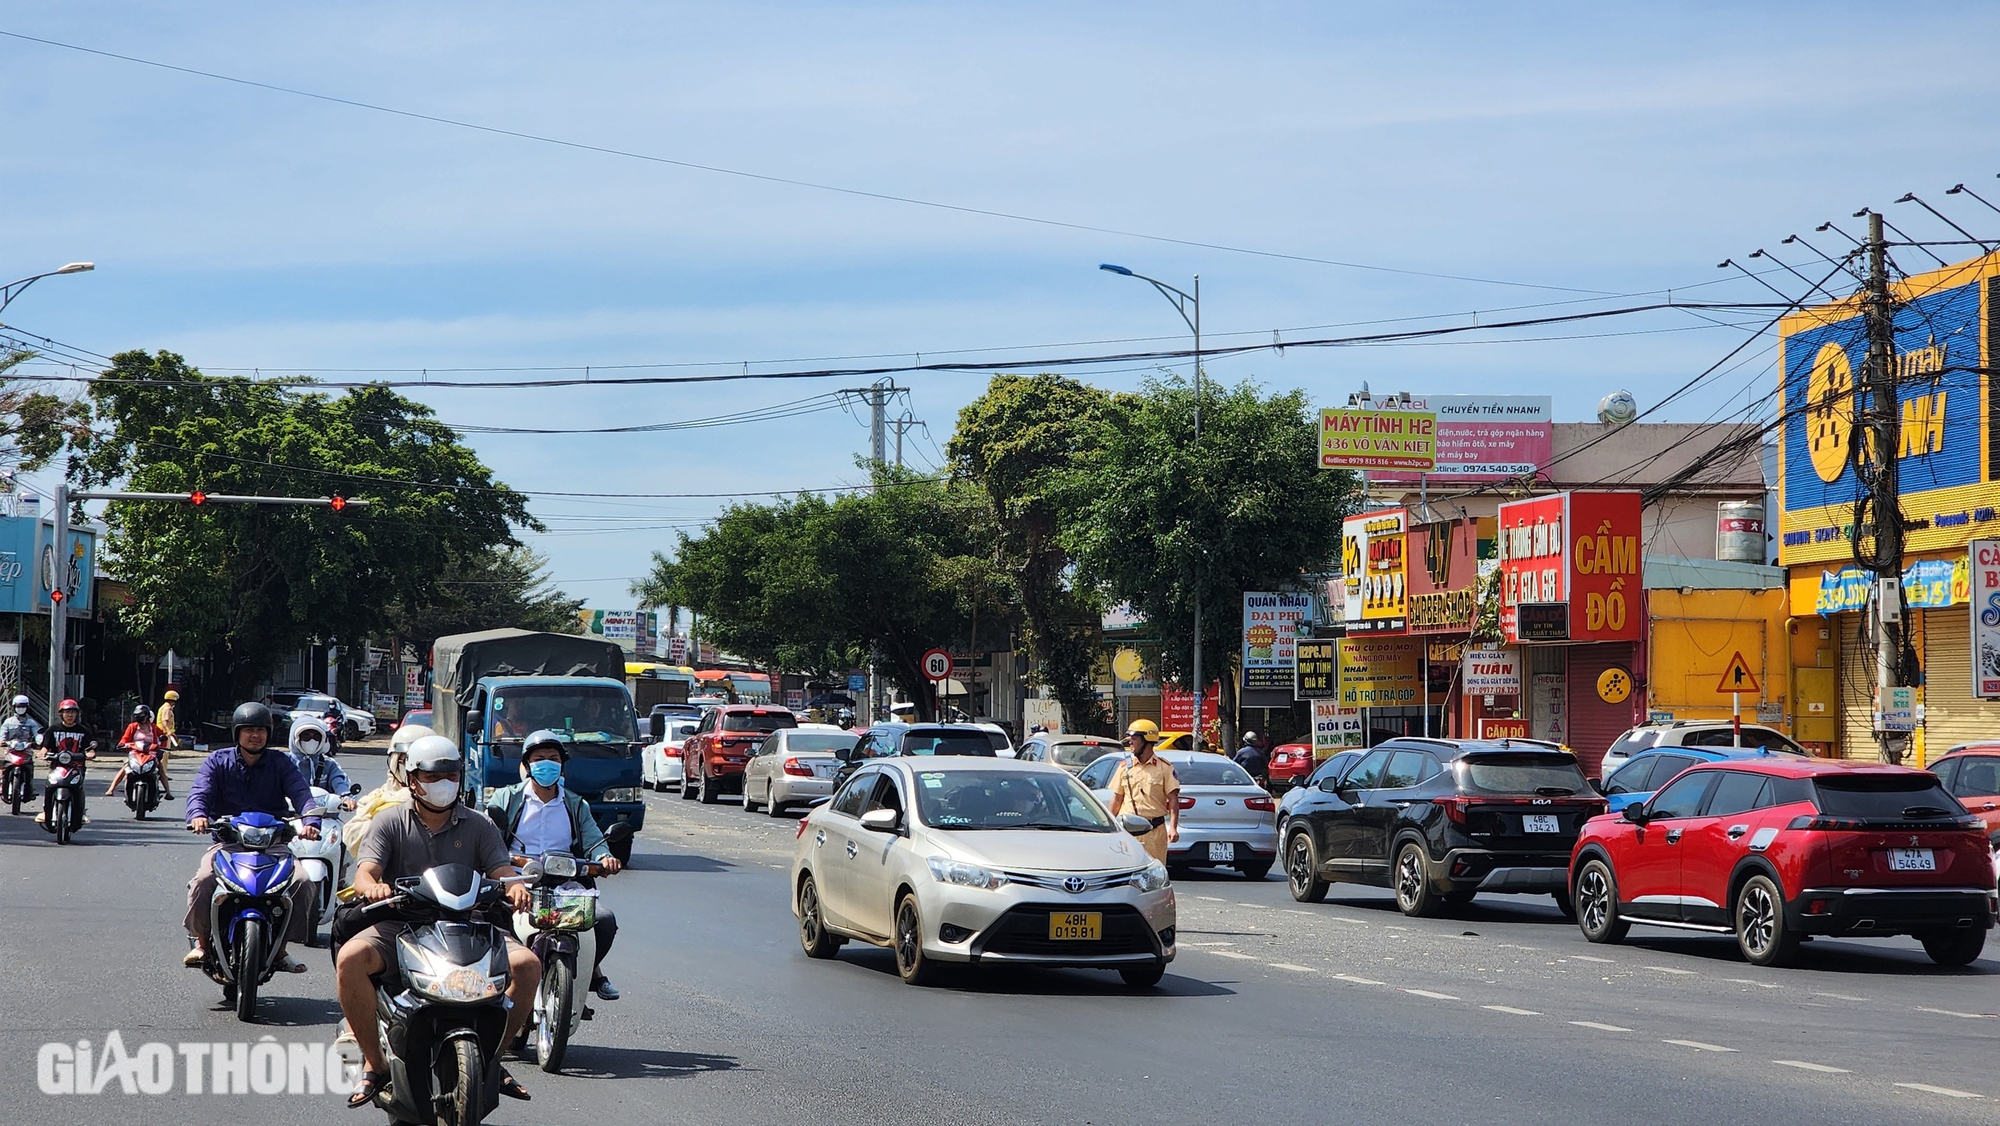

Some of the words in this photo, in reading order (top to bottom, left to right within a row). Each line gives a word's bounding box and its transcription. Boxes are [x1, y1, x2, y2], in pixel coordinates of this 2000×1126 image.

[1374, 399, 1429, 410] vittel
[1441, 402, 1480, 414] CHUYỂN
[1483, 402, 1504, 414] TIỀN
[1506, 406, 1541, 414] NHANH
[1409, 418, 1433, 435] H2
[1490, 429, 1504, 438] góp
[1506, 430, 1524, 438] ngân
[1526, 429, 1545, 438] hàng
[1325, 438, 1349, 450] 436
[1404, 438, 1431, 455] KIỆT
[1499, 440, 1515, 449] máy
[1325, 457, 1347, 465] Hotline:
[1348, 458, 1364, 466] 0979
[1447, 451, 1463, 460] máy
[1464, 451, 1478, 459] bay
[1434, 465, 1460, 473] otline:
[1463, 465, 1530, 473] 0974.540.540
[1426, 521, 1452, 585] 47
[1575, 520, 1637, 575] CẦM
[1343, 534, 1360, 575] H2
[1521, 571, 1539, 602] GIA
[1248, 595, 1276, 609] QUÁN
[1409, 594, 1446, 626] BARBER
[1446, 590, 1472, 624] SHOP
[1586, 577, 1626, 631] ĐỒ
[1251, 611, 1275, 623] ĐẠI
[1278, 609, 1305, 621] PHÚ
[1469, 651, 1487, 660] HIỆU
[1488, 651, 1506, 659] GIÀY
[930, 658, 944, 673] 60
[1299, 660, 1315, 674] MÁY
[1316, 660, 1332, 674] TÍNH
[1304, 675, 1316, 688] GIÁ
[1344, 687, 1357, 702] HỖ
[1359, 689, 1376, 703] TRỢ
[1379, 686, 1396, 701] TRẢ
[1398, 688, 1415, 701] GÓP
[1317, 704, 1336, 719] ĐẠI
[1486, 723, 1508, 738] CẦM
[1509, 723, 1525, 738] ĐỒ
[1316, 734, 1329, 745] KIM
[1533, 815, 1549, 823] 48C
[1529, 824, 1555, 832] 134.21
[1214, 843, 1228, 851] 47A
[1210, 851, 1233, 860] 269.45
[1904, 849, 1922, 858] 47A
[1898, 859, 1931, 869] 546.49
[1065, 914, 1087, 926] 48H
[1055, 926, 1094, 938] 019.81
